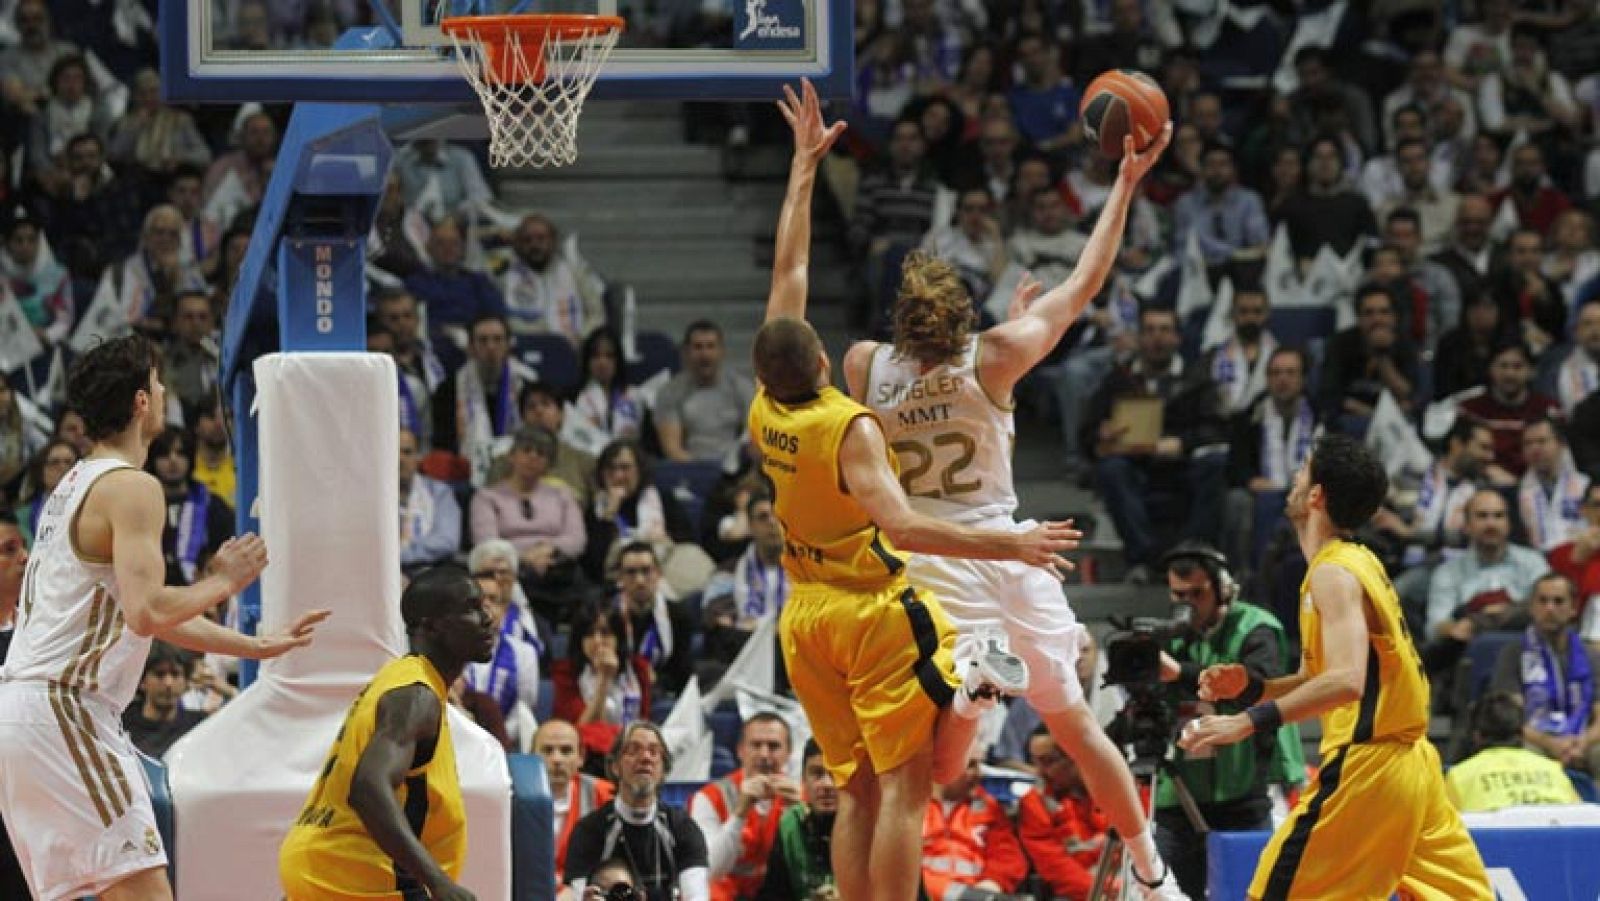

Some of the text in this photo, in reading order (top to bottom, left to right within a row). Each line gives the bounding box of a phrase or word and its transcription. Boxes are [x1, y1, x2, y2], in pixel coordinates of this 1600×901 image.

[315, 245, 333, 334] MONDO
[897, 403, 952, 426] MMT
[889, 431, 982, 499] 22
